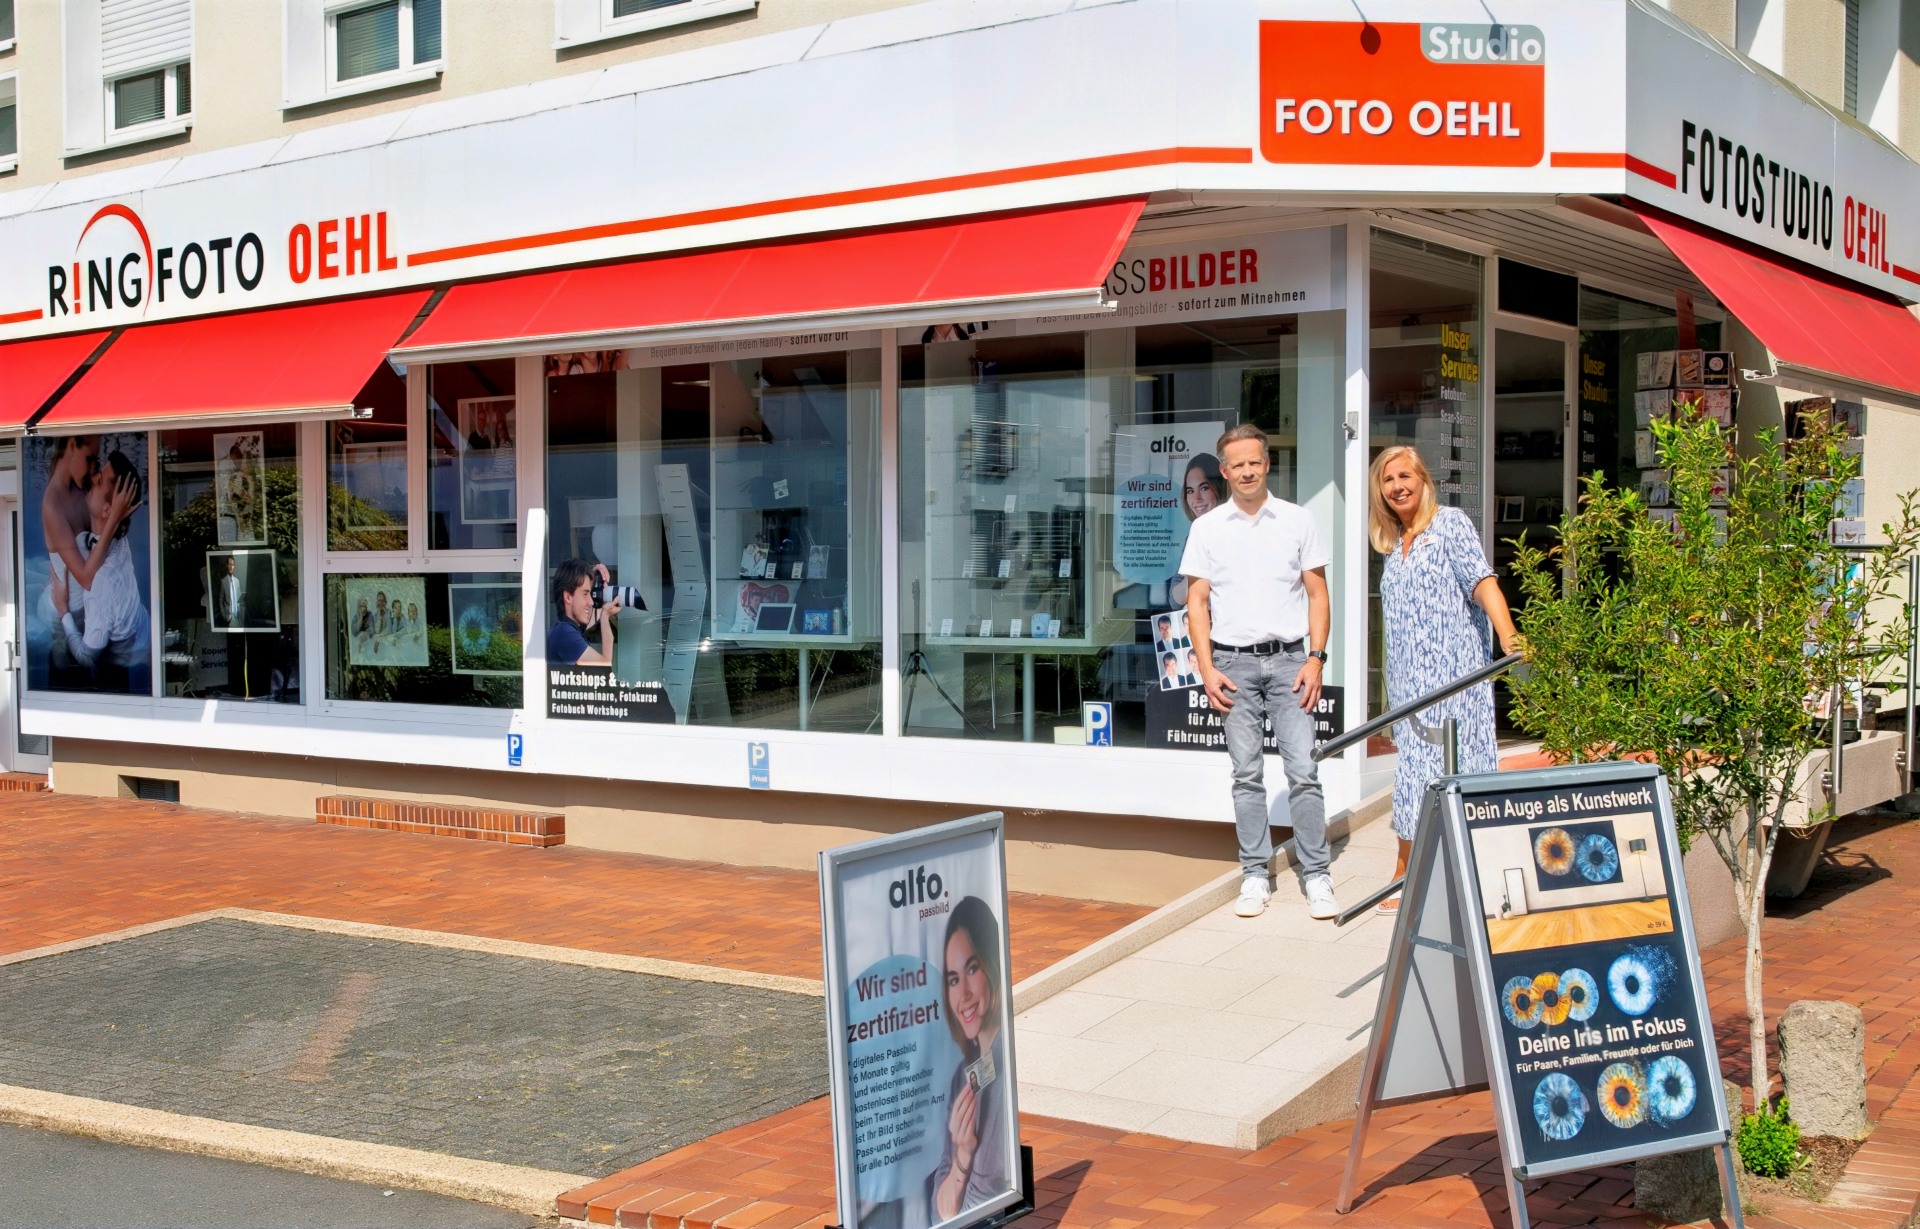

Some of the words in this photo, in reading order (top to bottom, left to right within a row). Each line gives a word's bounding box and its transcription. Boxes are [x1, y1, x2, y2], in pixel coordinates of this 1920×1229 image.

[1429, 26, 1542, 61] Studio
[1276, 98, 1393, 135] FOTO
[1409, 100, 1521, 137] OEHL
[1682, 119, 1833, 250] FOTOSTUDIO
[1843, 195, 1889, 274] OEHL
[288, 211, 397, 284] OEHL
[1178, 297, 1211, 311] sofort
[1214, 296, 1236, 308] zum
[1241, 290, 1306, 306] Mitnehmen
[650, 347, 677, 359] Bequem
[680, 345, 692, 355] und
[694, 341, 720, 354] schnell
[722, 342, 734, 352] von
[736, 339, 758, 352] jedem
[760, 337, 782, 349] Handy
[790, 334, 816, 345] sofort
[818, 333, 832, 342] vor
[1441, 323, 1470, 351] Unser
[1441, 353, 1478, 382] Service
[1583, 353, 1605, 376] Unser
[1440, 385, 1467, 401] Fotobuch
[1583, 379, 1608, 403] Studio
[1440, 409, 1477, 426] Scan-Service
[1150, 434, 1189, 453] alfo.
[1440, 433, 1452, 447] Bild
[1452, 436, 1464, 448] vom
[1440, 456, 1476, 474] Datenrettung
[1127, 480, 1146, 492] Wir
[1148, 480, 1172, 491] sind
[1440, 480, 1461, 495] Eigenes
[1121, 497, 1178, 509] zertifiziert
[550, 670, 606, 689] Workshops
[551, 688, 618, 703] Kameraseminare,
[619, 691, 658, 703] Fotokurse
[551, 703, 585, 714] Fotobuch
[587, 705, 628, 718] Workshops
[1188, 713, 1203, 726] für
[1085, 704, 1108, 743] P
[510, 735, 520, 756] P
[752, 745, 765, 766] P
[751, 774, 768, 783] Privat
[1464, 802, 1500, 821] Dein
[1503, 799, 1544, 820] Auge
[1547, 795, 1569, 814] als
[1572, 786, 1652, 811] Kunstwerk
[889, 865, 949, 909] alfo.
[919, 901, 950, 921] passbild
[856, 974, 885, 1002] Wir
[890, 962, 927, 993] sind
[847, 999, 939, 1044] zertifiziert
[1518, 1033, 1571, 1056] Deine
[1574, 1026, 1603, 1048] Iris
[1605, 1024, 1630, 1043] im
[1631, 1017, 1686, 1039] Fokus
[853, 1052, 885, 1068] digitales
[886, 1042, 917, 1059] Passbild
[1516, 1061, 1532, 1073] Für
[1533, 1058, 1562, 1072] Paare,
[1562, 1052, 1602, 1067] Familien,
[1602, 1045, 1639, 1060] Freunde
[1640, 1041, 1660, 1054] oder
[1661, 1039, 1673, 1051] für
[1674, 1038, 1694, 1049] Dich
[853, 1073, 859, 1083] 6
[860, 1067, 888, 1082] Monate
[890, 1060, 910, 1076] gültig
[854, 1085, 868, 1098] und
[870, 1068, 934, 1094] wiederverwendbar
[854, 1093, 899, 1114] kostenloses
[900, 1083, 930, 1100] Bilderset
[855, 1116, 873, 1129] beim
[874, 1108, 901, 1123] Termin
[902, 1102, 914, 1115] auf
[931, 1093, 945, 1105] Amt
[855, 1134, 865, 1144] ist
[866, 1130, 877, 1141] Ihr
[878, 1124, 893, 1136] Bild
[856, 1163, 867, 1175] für
[868, 1158, 882, 1170] alle
